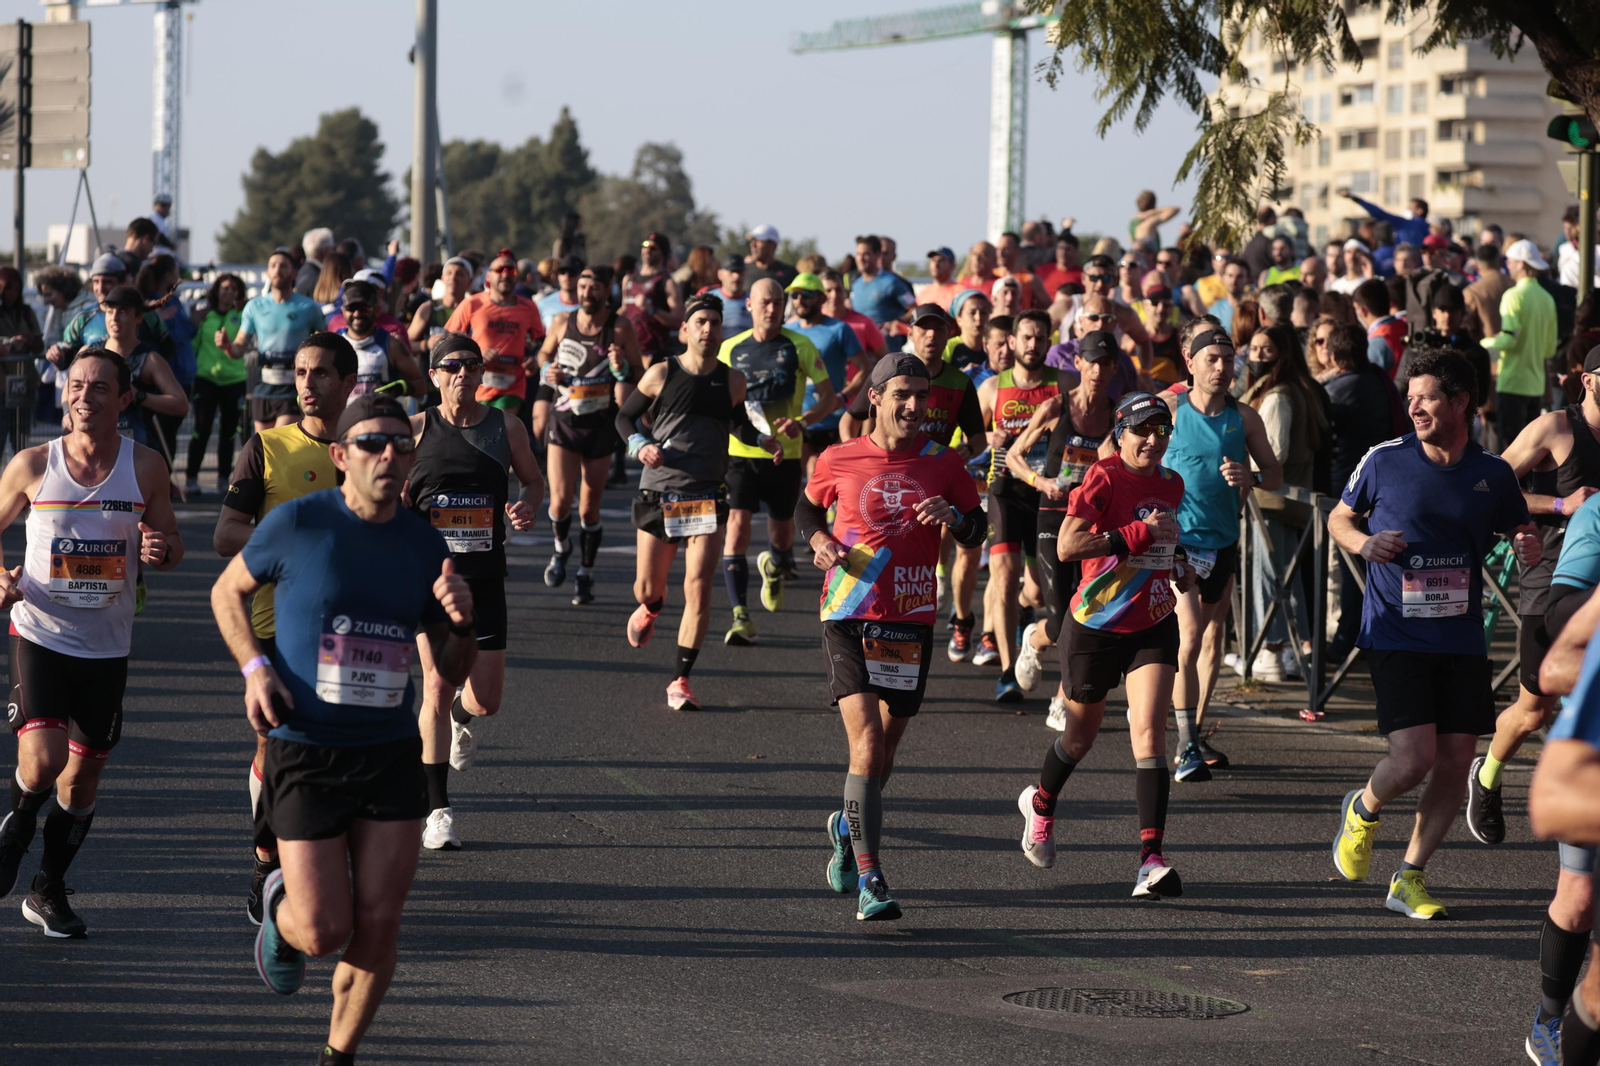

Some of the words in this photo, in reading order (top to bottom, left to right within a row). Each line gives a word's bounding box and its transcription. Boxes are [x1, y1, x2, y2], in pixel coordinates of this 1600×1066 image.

[102, 500, 133, 513] 226ERS
[451, 497, 487, 506] ZURICH
[451, 515, 472, 525] 4611
[76, 543, 118, 553] ZURICH
[1426, 557, 1463, 566] ZURICH
[76, 564, 102, 575] 4886
[894, 565, 934, 582] RUN
[68, 581, 108, 591] BAPTISTA
[1426, 576, 1449, 587] 6919
[894, 581, 934, 596] NING
[893, 592, 934, 613] Team
[1425, 593, 1450, 601] BORJA
[353, 620, 405, 639] ZURICH
[882, 630, 918, 640] ZURICH
[352, 648, 383, 665] 7140
[880, 663, 899, 673] TOMAS
[350, 671, 376, 683] PJVC
